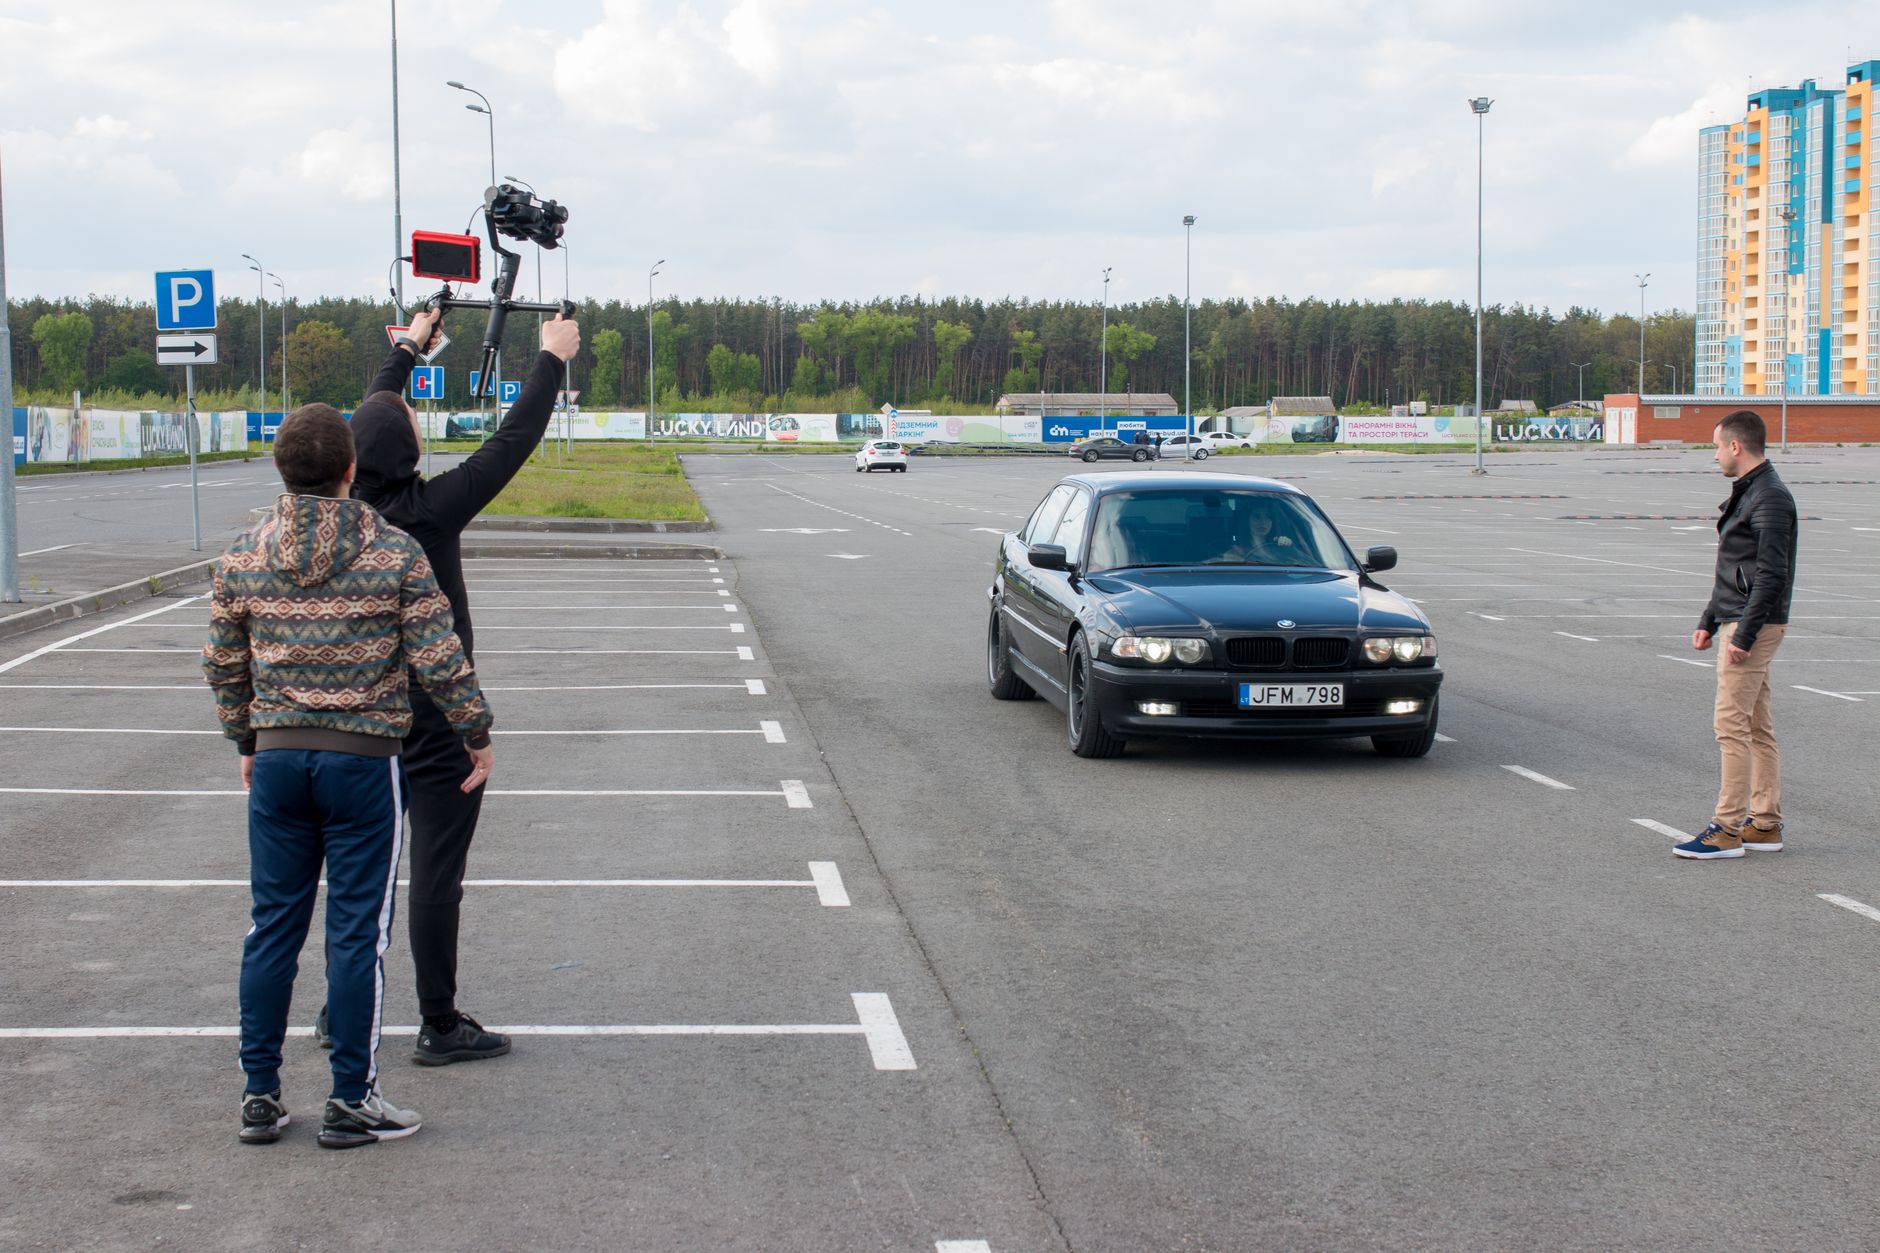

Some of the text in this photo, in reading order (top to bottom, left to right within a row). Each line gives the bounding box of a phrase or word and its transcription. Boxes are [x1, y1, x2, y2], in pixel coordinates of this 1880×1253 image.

[171, 277, 203, 323] P
[504, 384, 516, 400] P
[717, 420, 762, 436] LAND
[1252, 687, 1294, 704] JFM
[1306, 686, 1340, 704] 798
